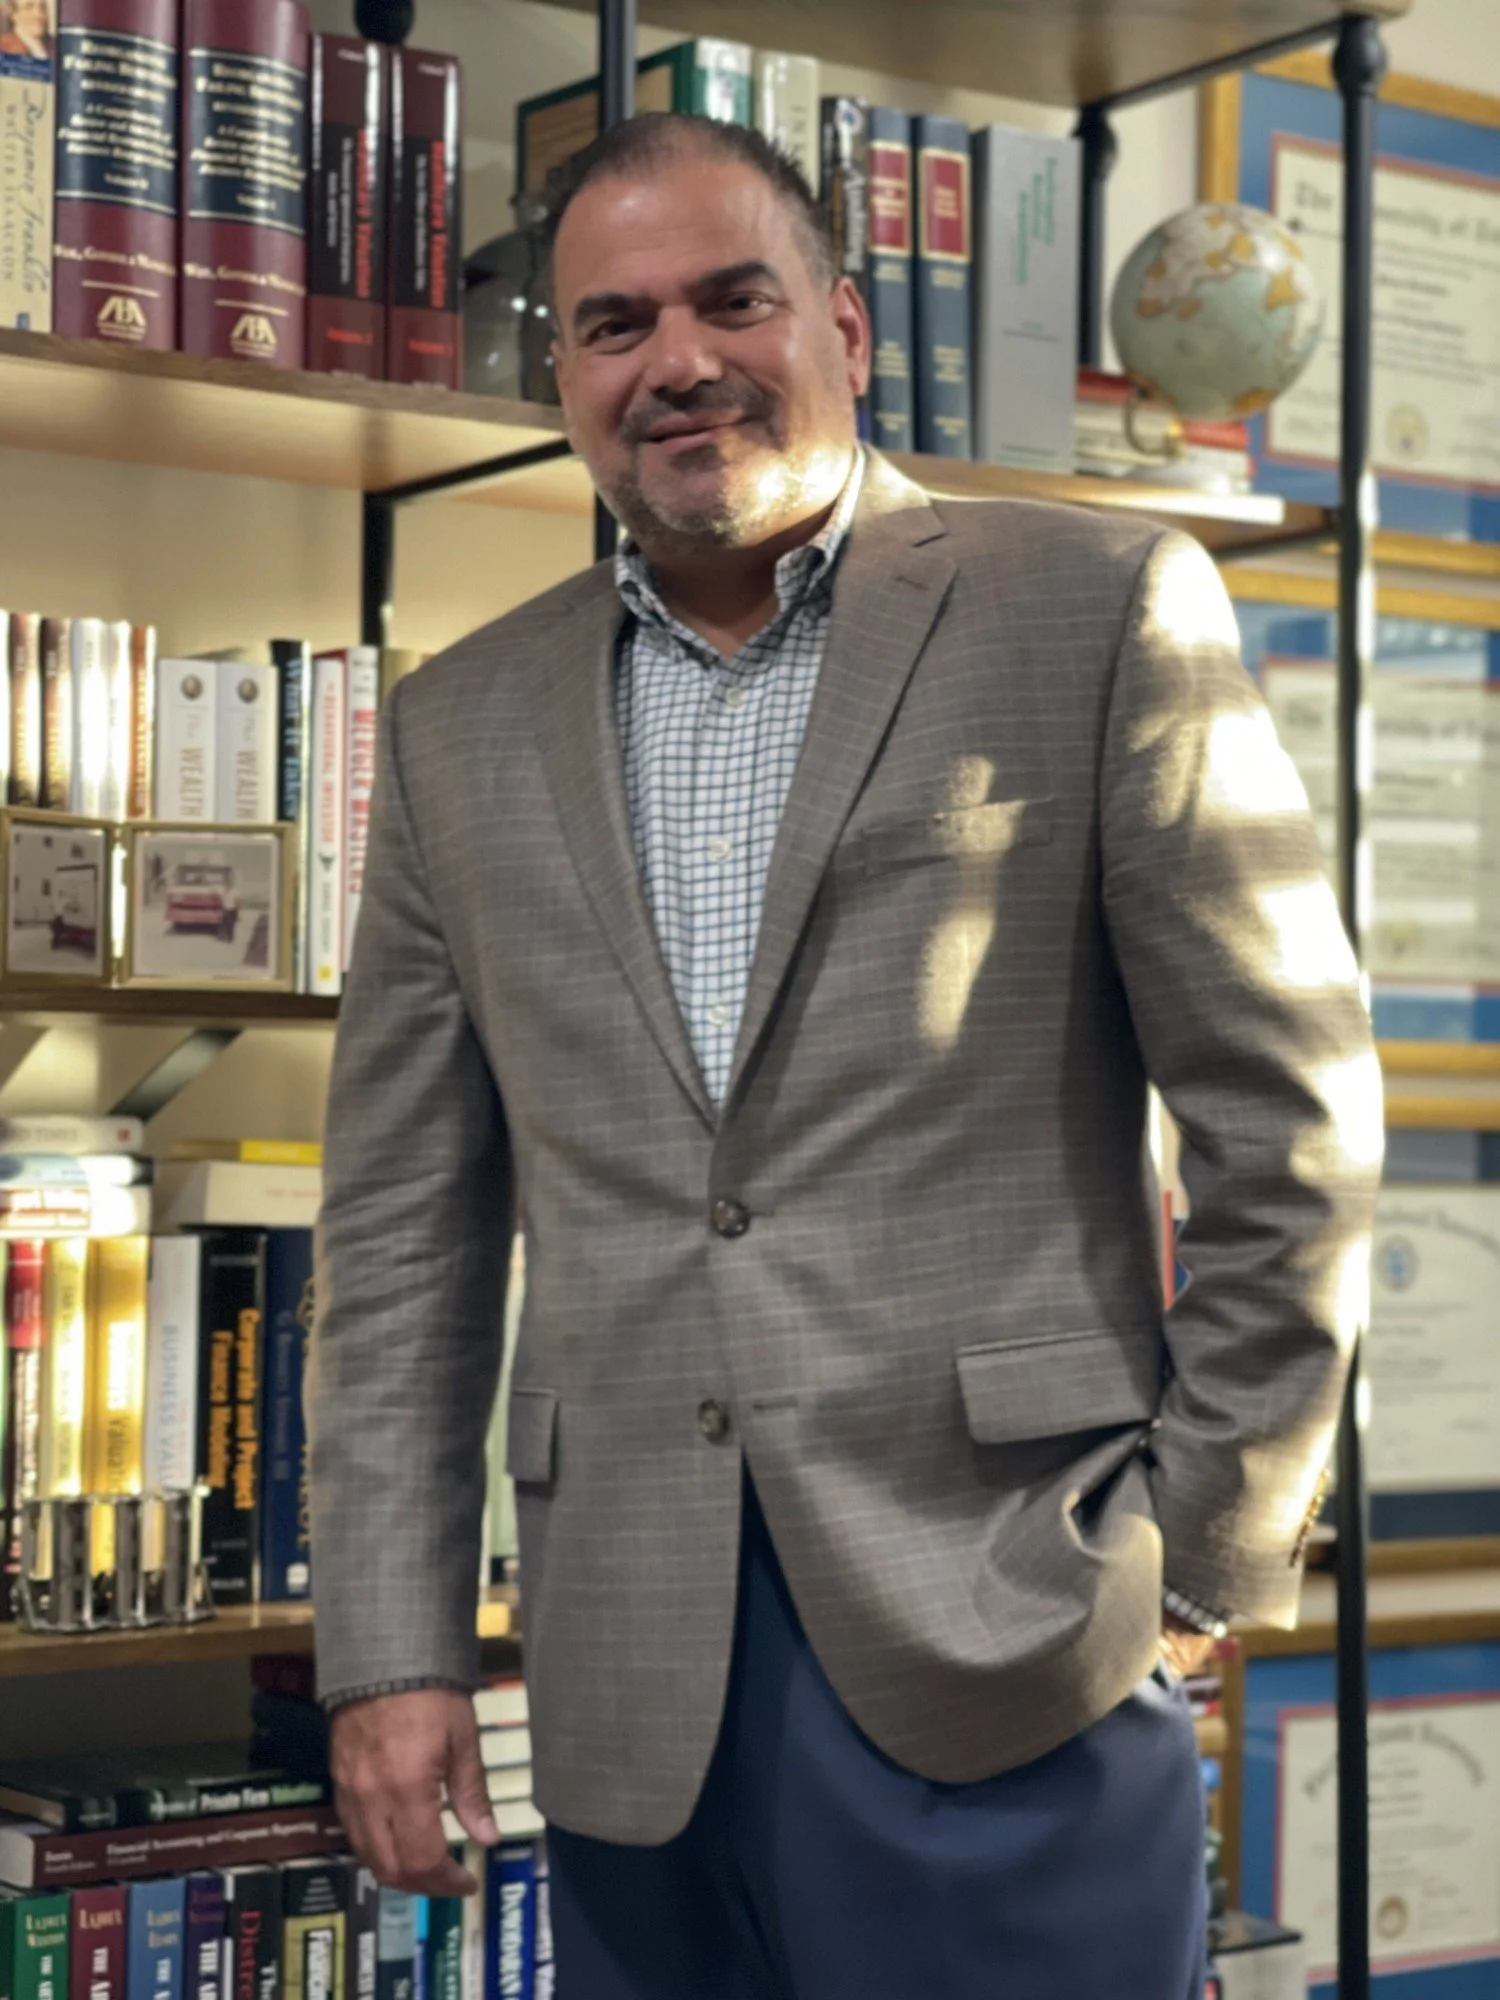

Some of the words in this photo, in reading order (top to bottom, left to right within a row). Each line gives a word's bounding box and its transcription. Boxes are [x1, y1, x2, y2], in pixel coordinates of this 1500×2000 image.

[4, 105, 17, 176] WALTER
[17, 88, 47, 195] Benjamin
[4, 186, 16, 283] ISAACSON
[20, 194, 50, 294] Franklin
[429, 233, 446, 309] Valuation
[97, 296, 147, 328] ABA
[230, 314, 278, 345] ABA
[285, 657, 303, 719] What
[284, 726, 301, 745] It
[180, 747, 203, 817] WEALTH
[236, 750, 258, 820] WEALTH
[284, 755, 301, 818] Takes
[159, 1324, 181, 1426] BUSINESS
[210, 1330, 234, 1403] Finance
[236, 1307, 260, 1402] Corporate
[107, 1416, 131, 1492] Valuati
[236, 1404, 258, 1440] and
[233, 1441, 258, 1510] Project
[199, 1791, 242, 1812] Private
[242, 1786, 270, 1808] Firm
[106, 1839, 151, 1857] Financial
[152, 1833, 205, 1852] Accounting
[206, 1830, 223, 1844] and
[271, 1820, 319, 1838] Reporting
[92, 1946, 109, 1975] THE
[198, 1938, 219, 1976] THE
